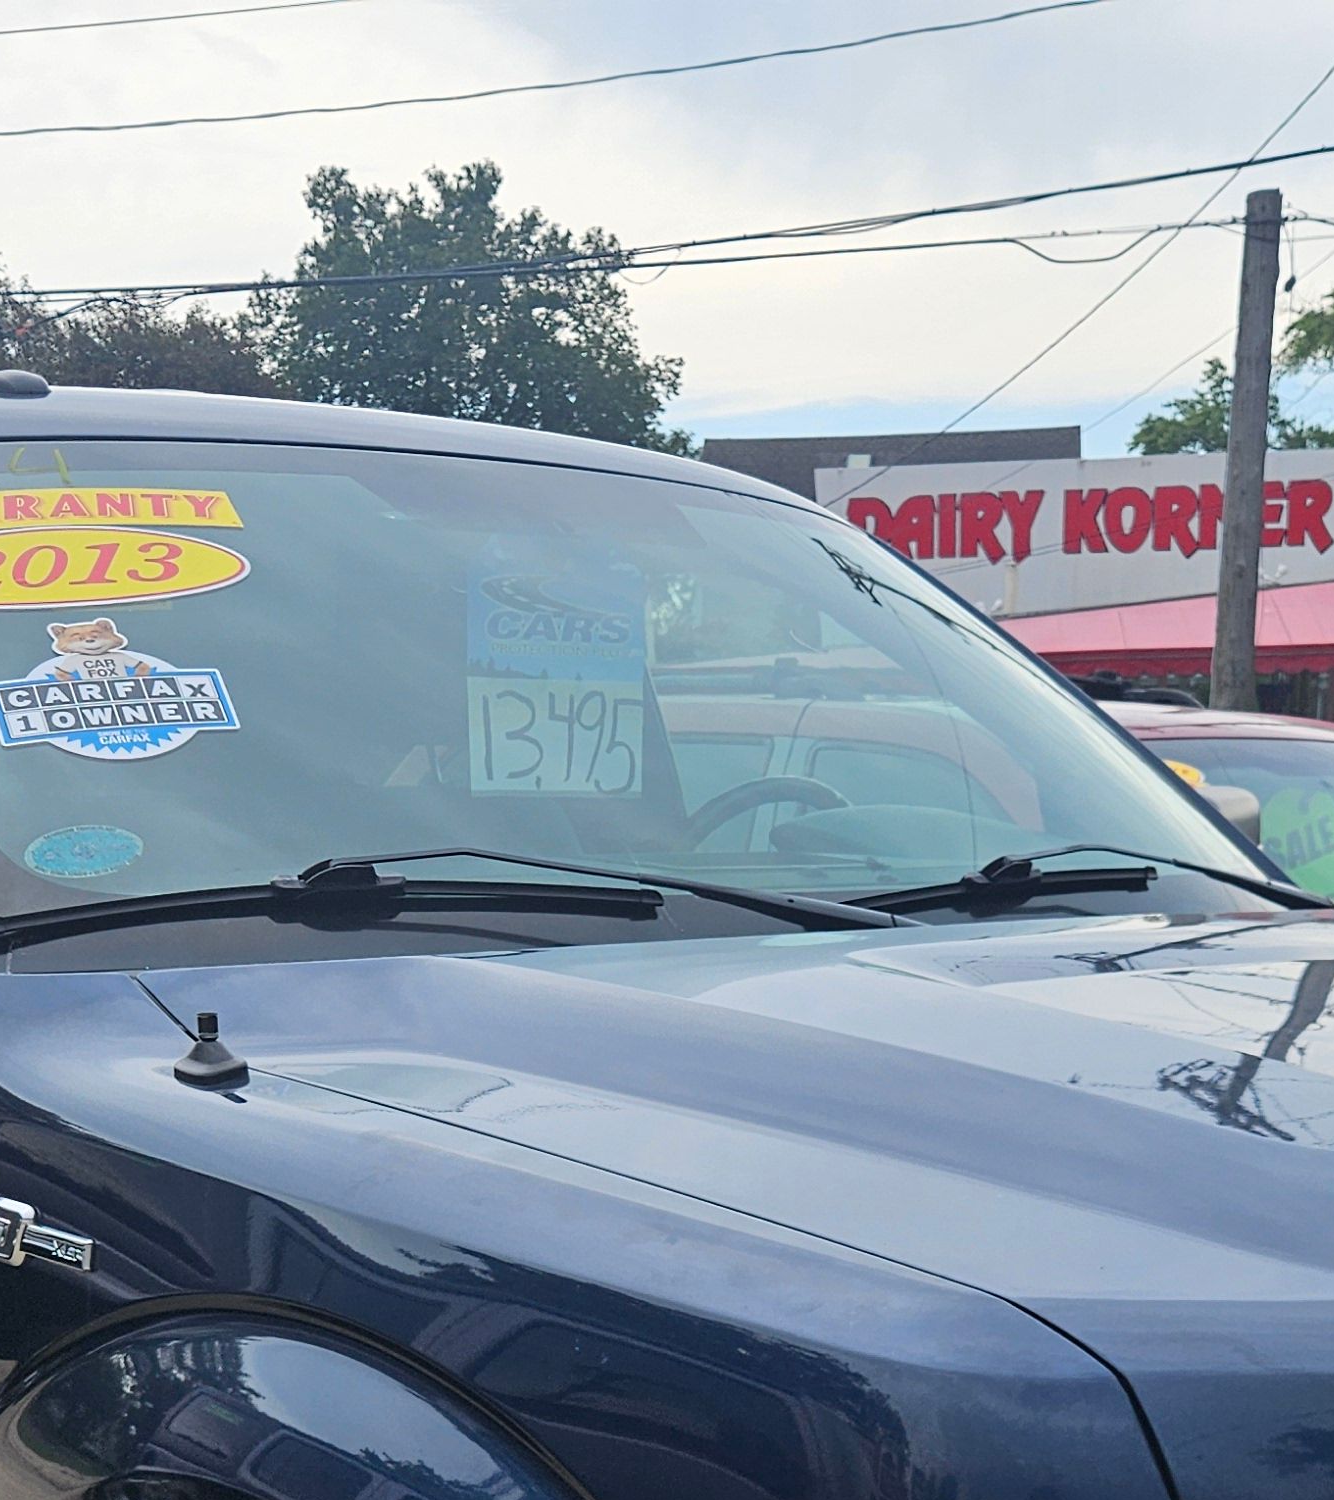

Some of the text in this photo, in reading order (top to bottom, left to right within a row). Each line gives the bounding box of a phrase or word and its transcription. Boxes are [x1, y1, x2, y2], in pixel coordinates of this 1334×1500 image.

[847, 488, 1045, 566] DAIRY
[485, 610, 632, 645] CARS
[82, 658, 116, 670] CAR
[87, 667, 119, 678] FOX
[7, 680, 208, 709] CARFAX
[99, 732, 151, 745] CARFAX
[482, 689, 644, 795] 13,495
